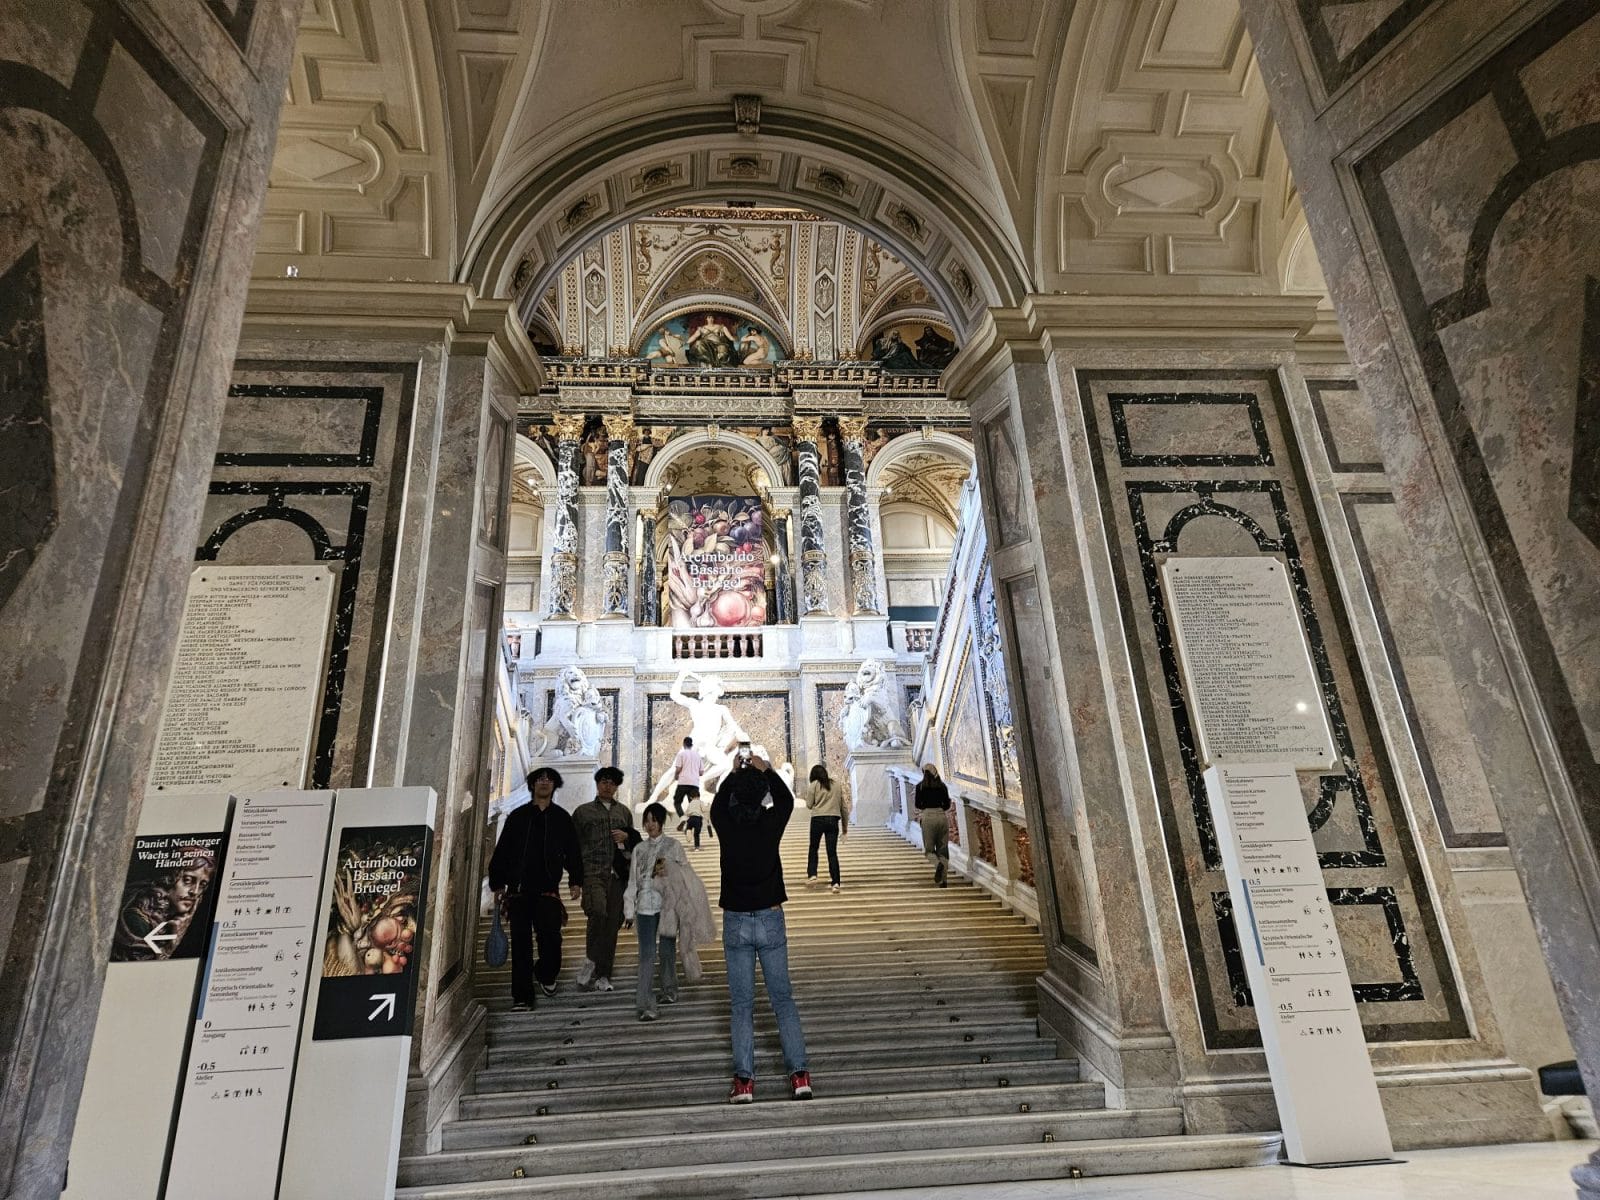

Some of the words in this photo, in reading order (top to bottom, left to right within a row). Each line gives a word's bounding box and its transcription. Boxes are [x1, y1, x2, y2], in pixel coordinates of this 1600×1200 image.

[680, 552, 754, 562] Arcimboldo
[690, 564, 743, 575] Bassano
[693, 577, 742, 590] Bruegel
[136, 838, 168, 849] Daniel
[171, 838, 221, 848] Neuberger
[138, 851, 169, 860] Wachs
[184, 850, 214, 858] seinen
[155, 858, 194, 868] Händen
[343, 856, 416, 870] Arcimboldo
[353, 869, 404, 881] Bassano
[353, 881, 401, 894] Bruegel
[197, 1062, 216, 1071] -0.5
